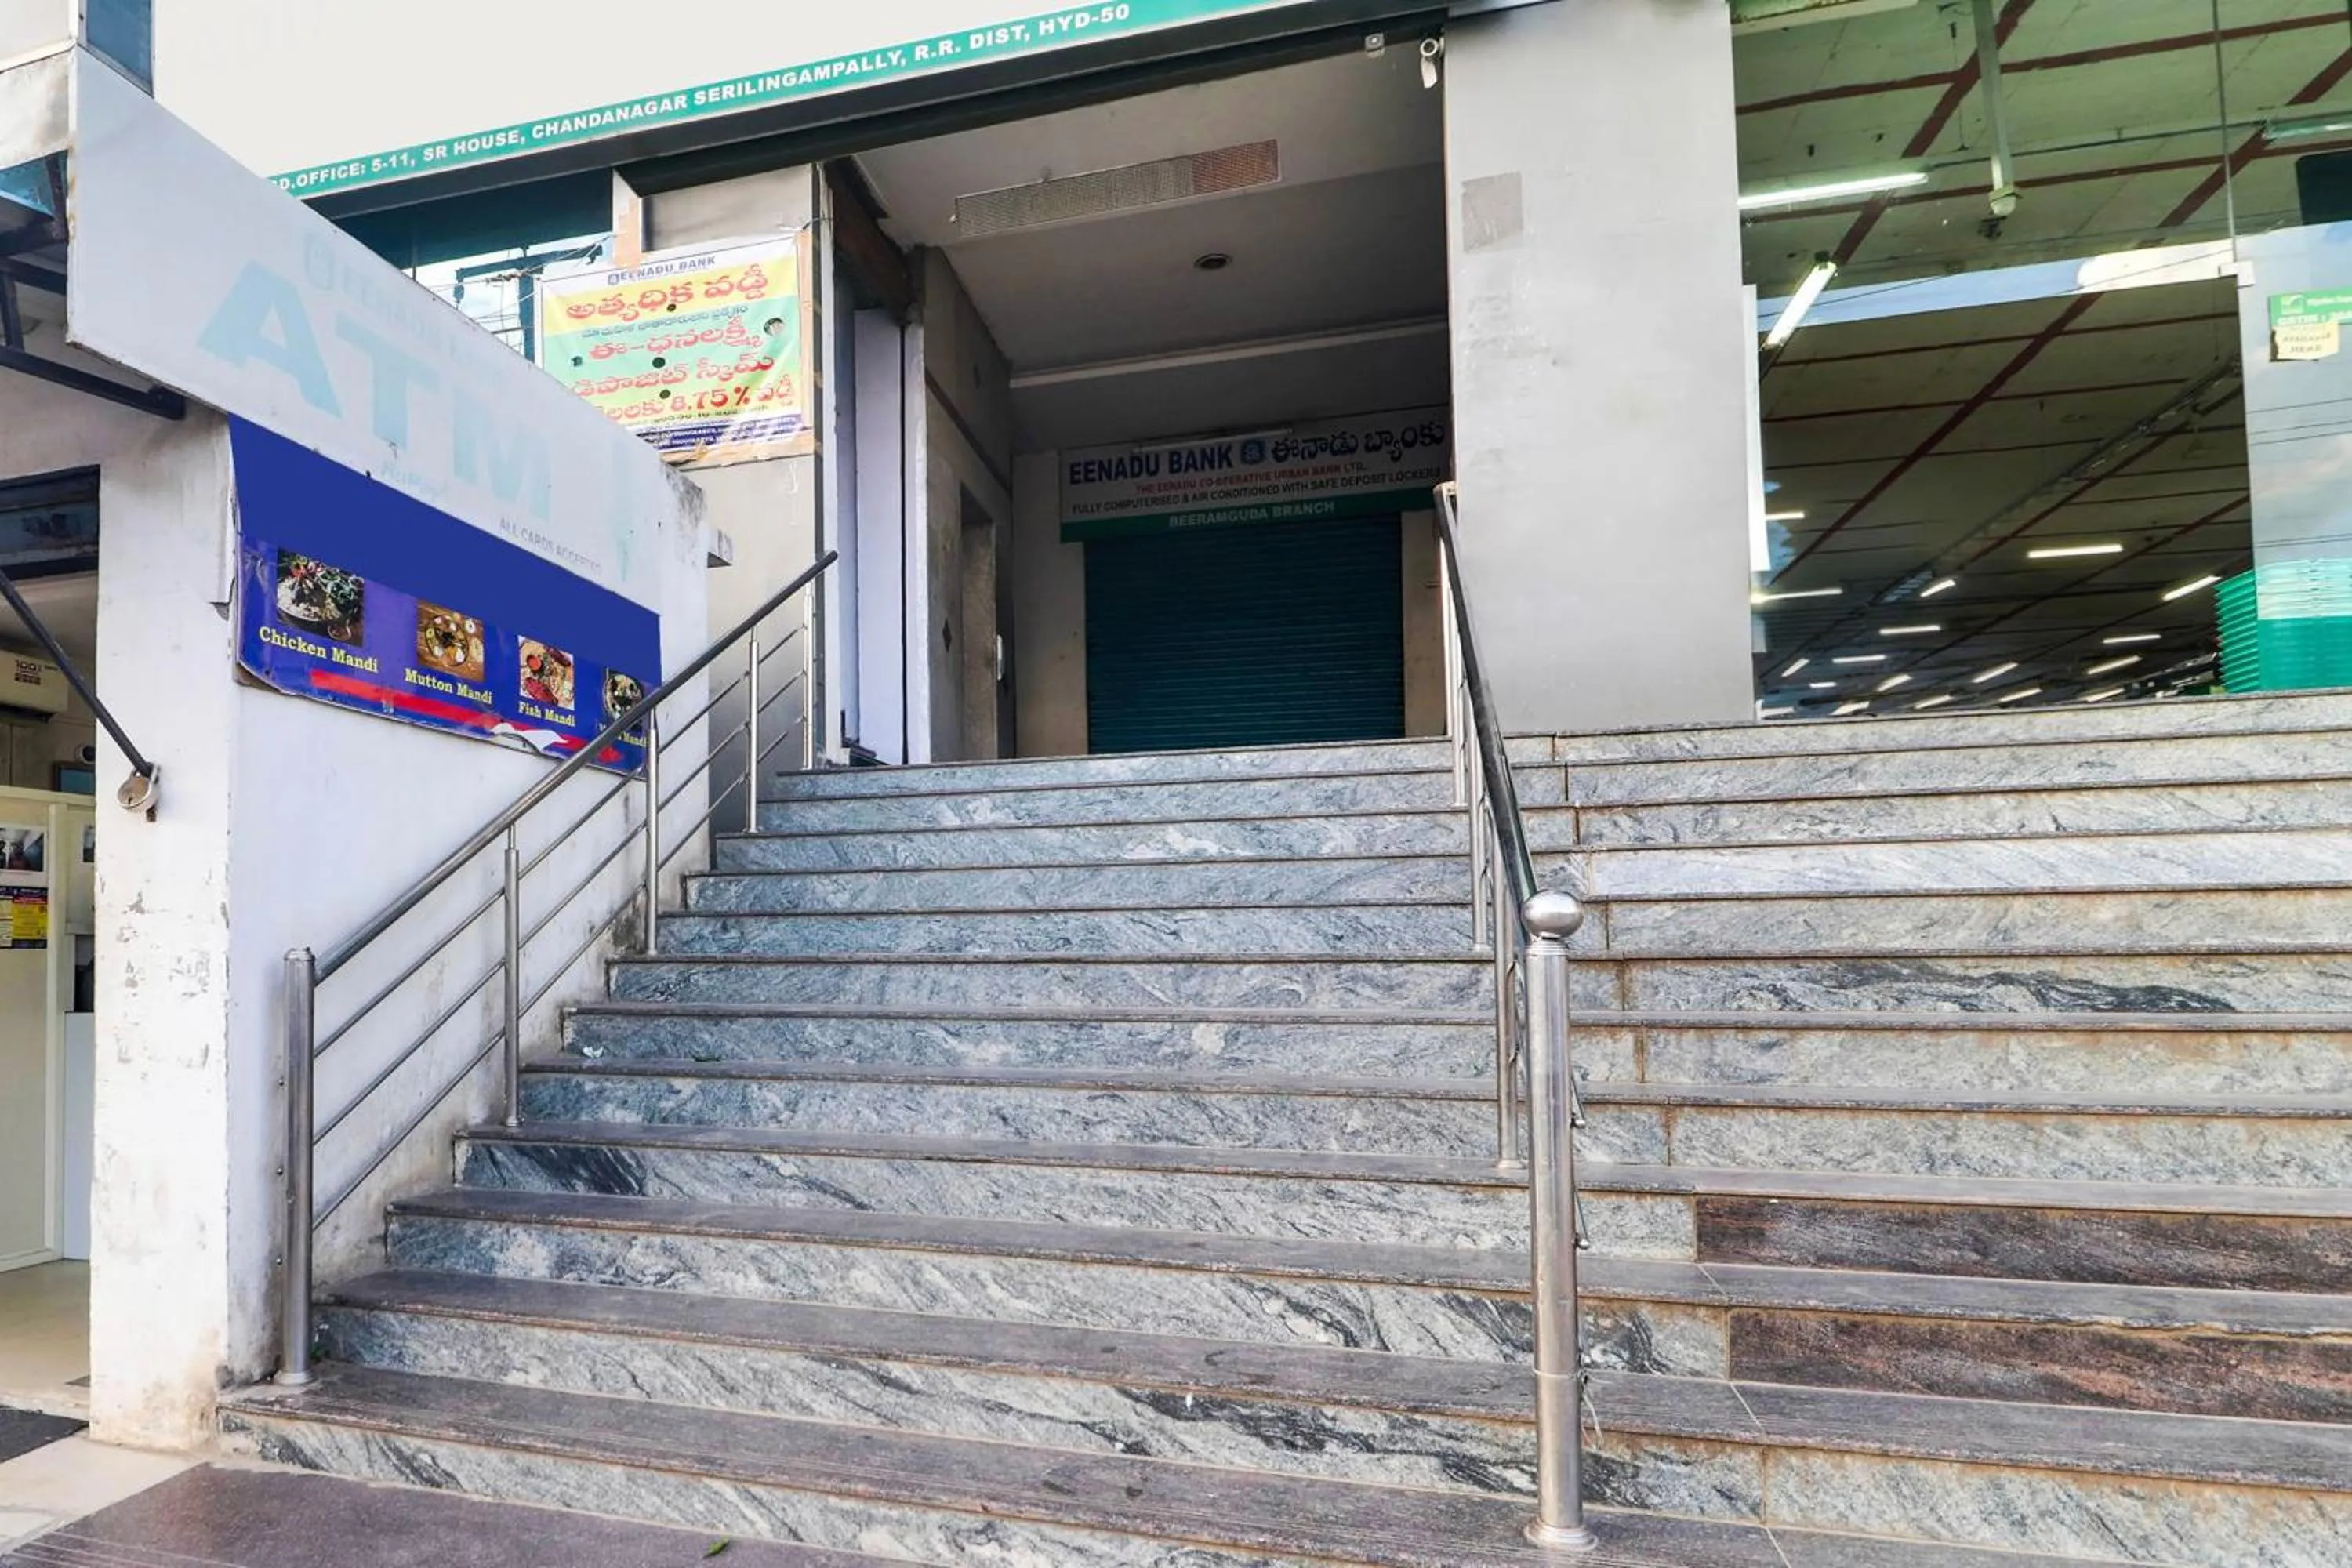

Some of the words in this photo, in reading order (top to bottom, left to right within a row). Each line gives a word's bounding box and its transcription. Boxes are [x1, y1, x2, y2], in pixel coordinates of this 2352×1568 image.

[272, 162, 366, 190] D.OFFICE:
[372, 153, 416, 172] 5-11,
[423, 144, 448, 162] SR
[454, 130, 526, 155] HOUSE,
[532, 94, 688, 140] CHANDANAGAR
[694, 50, 907, 106] SERILINGAMPALLY,
[915, 39, 960, 62] R.R.
[969, 26, 1030, 50] DIST,
[1038, 3, 1131, 36] HYD-50
[679, 256, 716, 270] BANK
[566, 282, 694, 322] అత్యధిక
[704, 263, 768, 300] వడ్డీ
[198, 260, 550, 520] ATM
[1272, 430, 1359, 462] ఈనాడు
[1364, 421, 1445, 463] బ్యాంకు
[1069, 452, 1160, 485] EENADU
[1170, 444, 1233, 474] BANK
[1073, 501, 1102, 514] FULLY
[1104, 495, 1180, 511] COMPUTERISED
[1192, 492, 1208, 503] AIR
[1211, 484, 1279, 501] CONDITIONED
[1282, 481, 1309, 493] WITH
[1311, 477, 1338, 489] SAFE
[1341, 472, 1388, 487] DEPOSIT
[1136, 483, 1156, 494] THE
[1158, 480, 1196, 492] EENADU
[1169, 506, 1268, 528] BEERAMGUDA
[1272, 500, 1335, 517] BRANCH
[260, 626, 327, 659] Chicken
[332, 648, 379, 673] Mandi
[405, 668, 453, 694] Mutton
[457, 682, 492, 704] Mandi
[518, 701, 542, 719] Fish
[545, 708, 575, 727] Mandi
